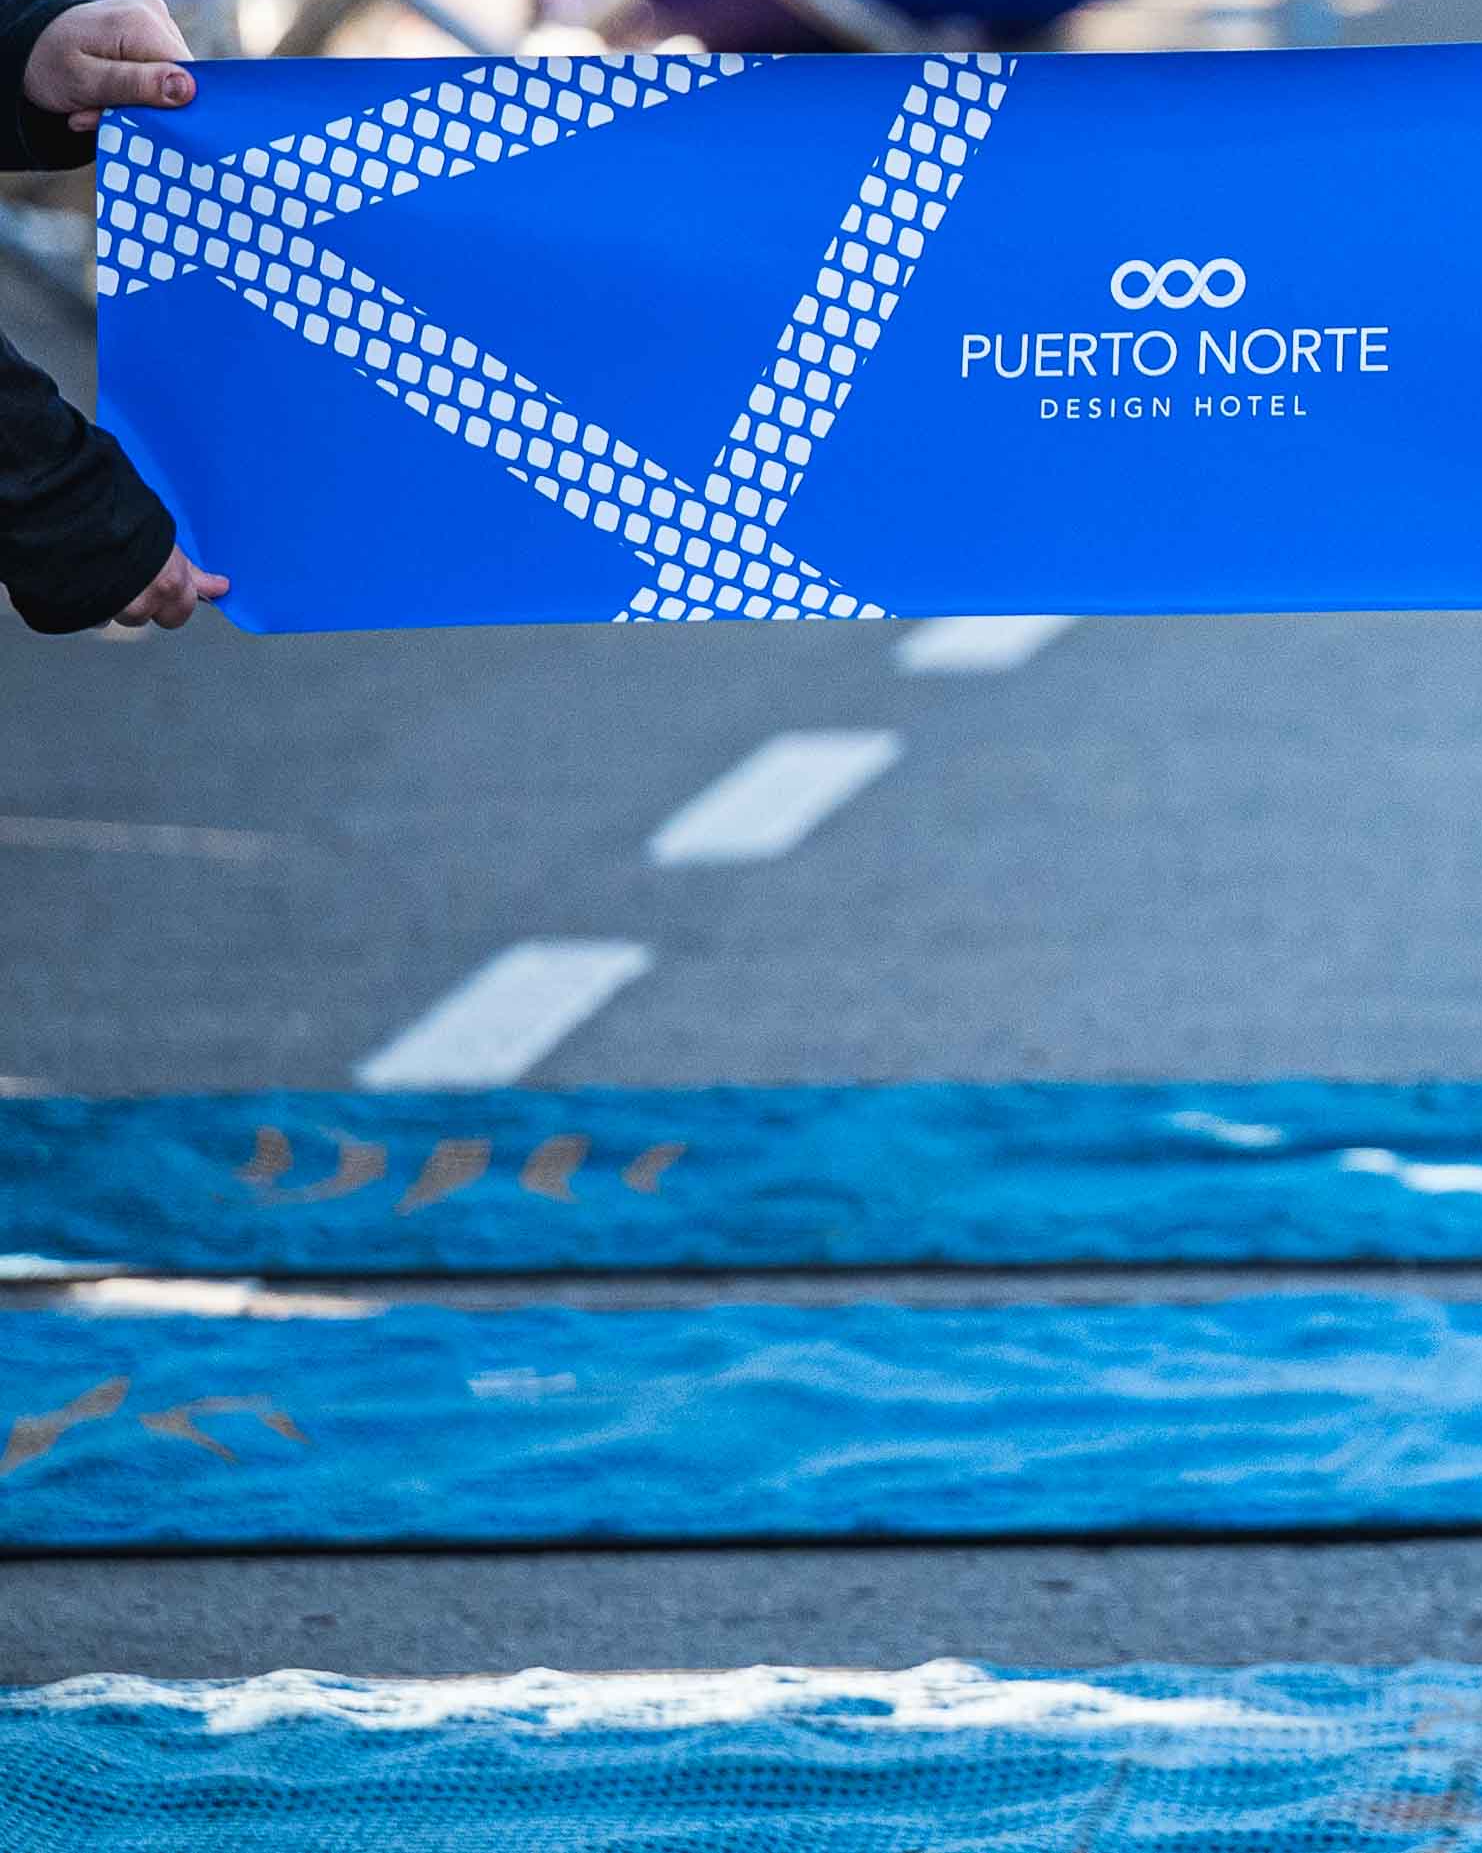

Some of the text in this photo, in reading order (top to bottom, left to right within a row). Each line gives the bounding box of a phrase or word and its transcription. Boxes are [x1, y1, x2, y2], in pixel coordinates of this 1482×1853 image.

[962, 327, 1389, 378] PUERTO NORTE
[1040, 395, 1307, 419] DESIGN HOTEL
